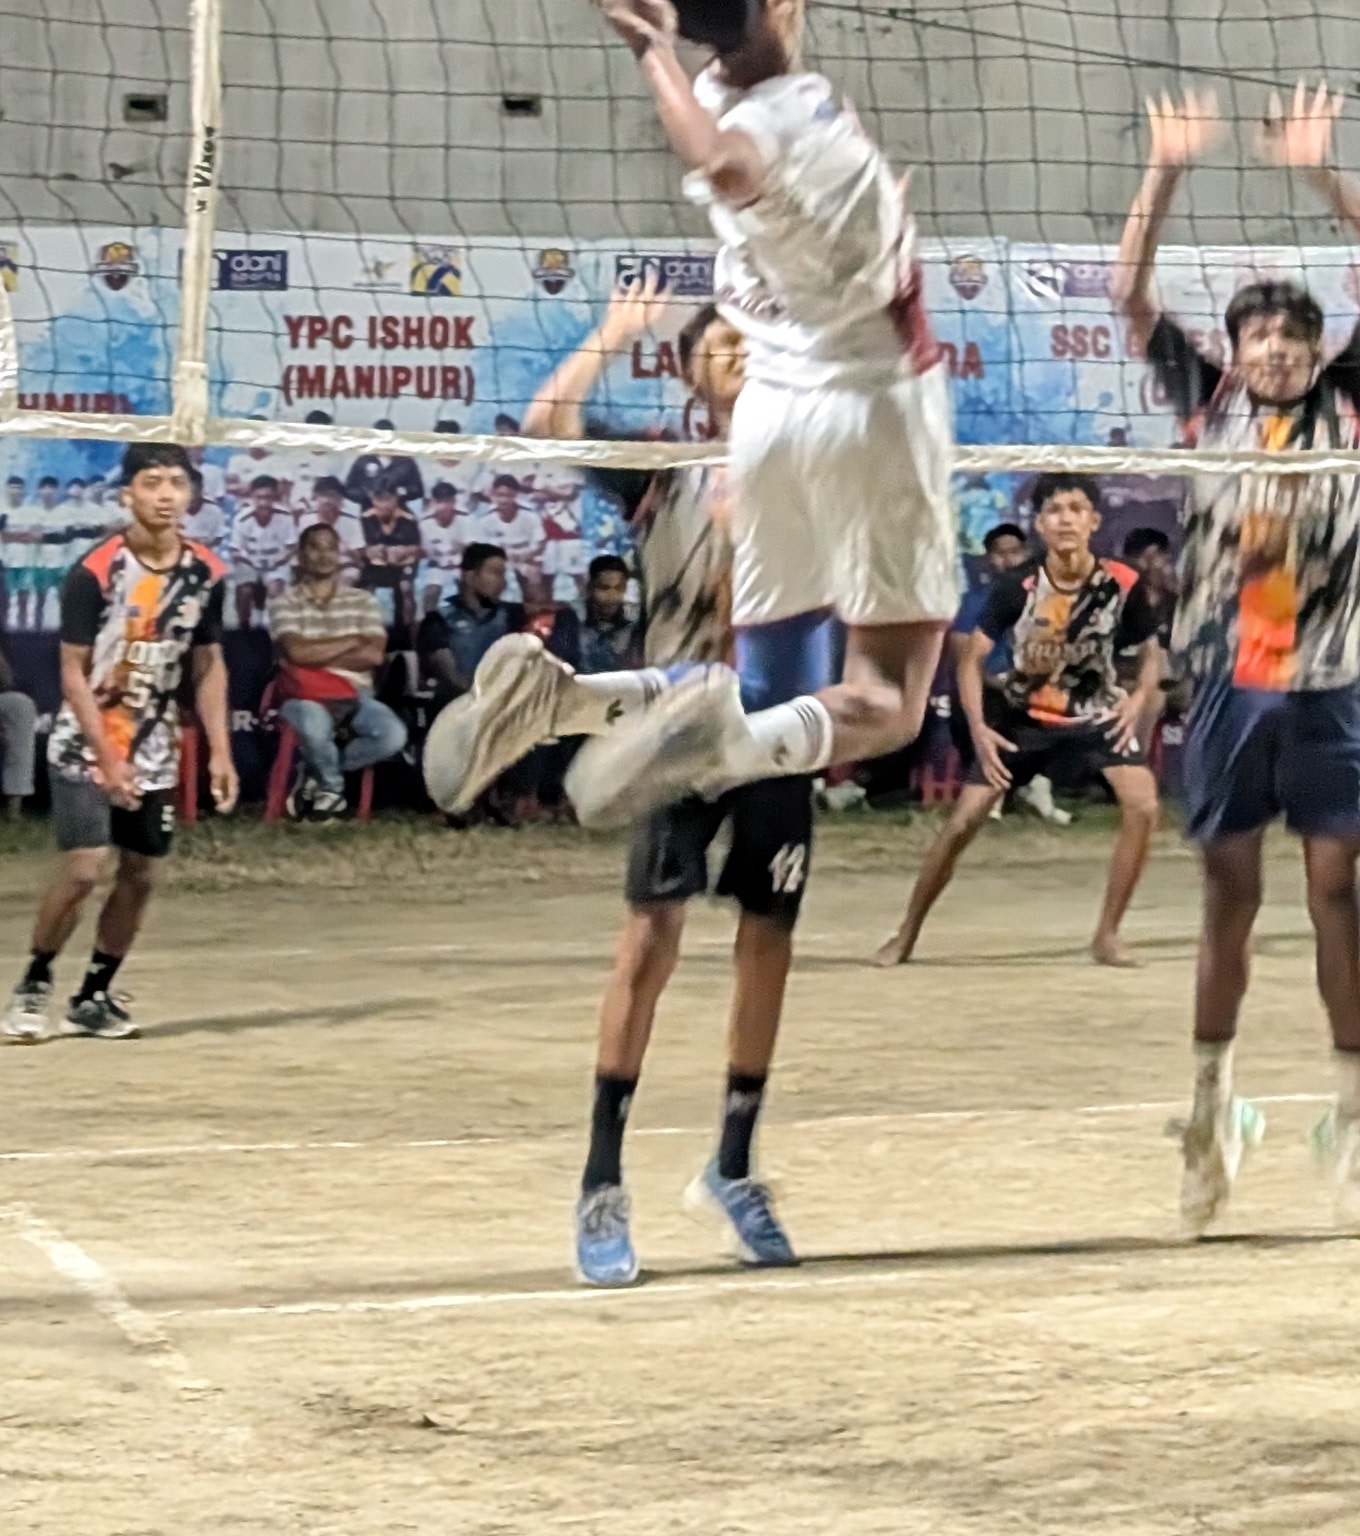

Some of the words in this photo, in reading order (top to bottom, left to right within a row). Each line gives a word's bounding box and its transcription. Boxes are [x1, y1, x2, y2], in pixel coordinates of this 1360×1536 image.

[284, 315, 354, 349] YPC
[368, 315, 475, 350] ISHOK
[1051, 325, 1111, 358] SSC
[282, 364, 475, 406] (MANIPUR)
